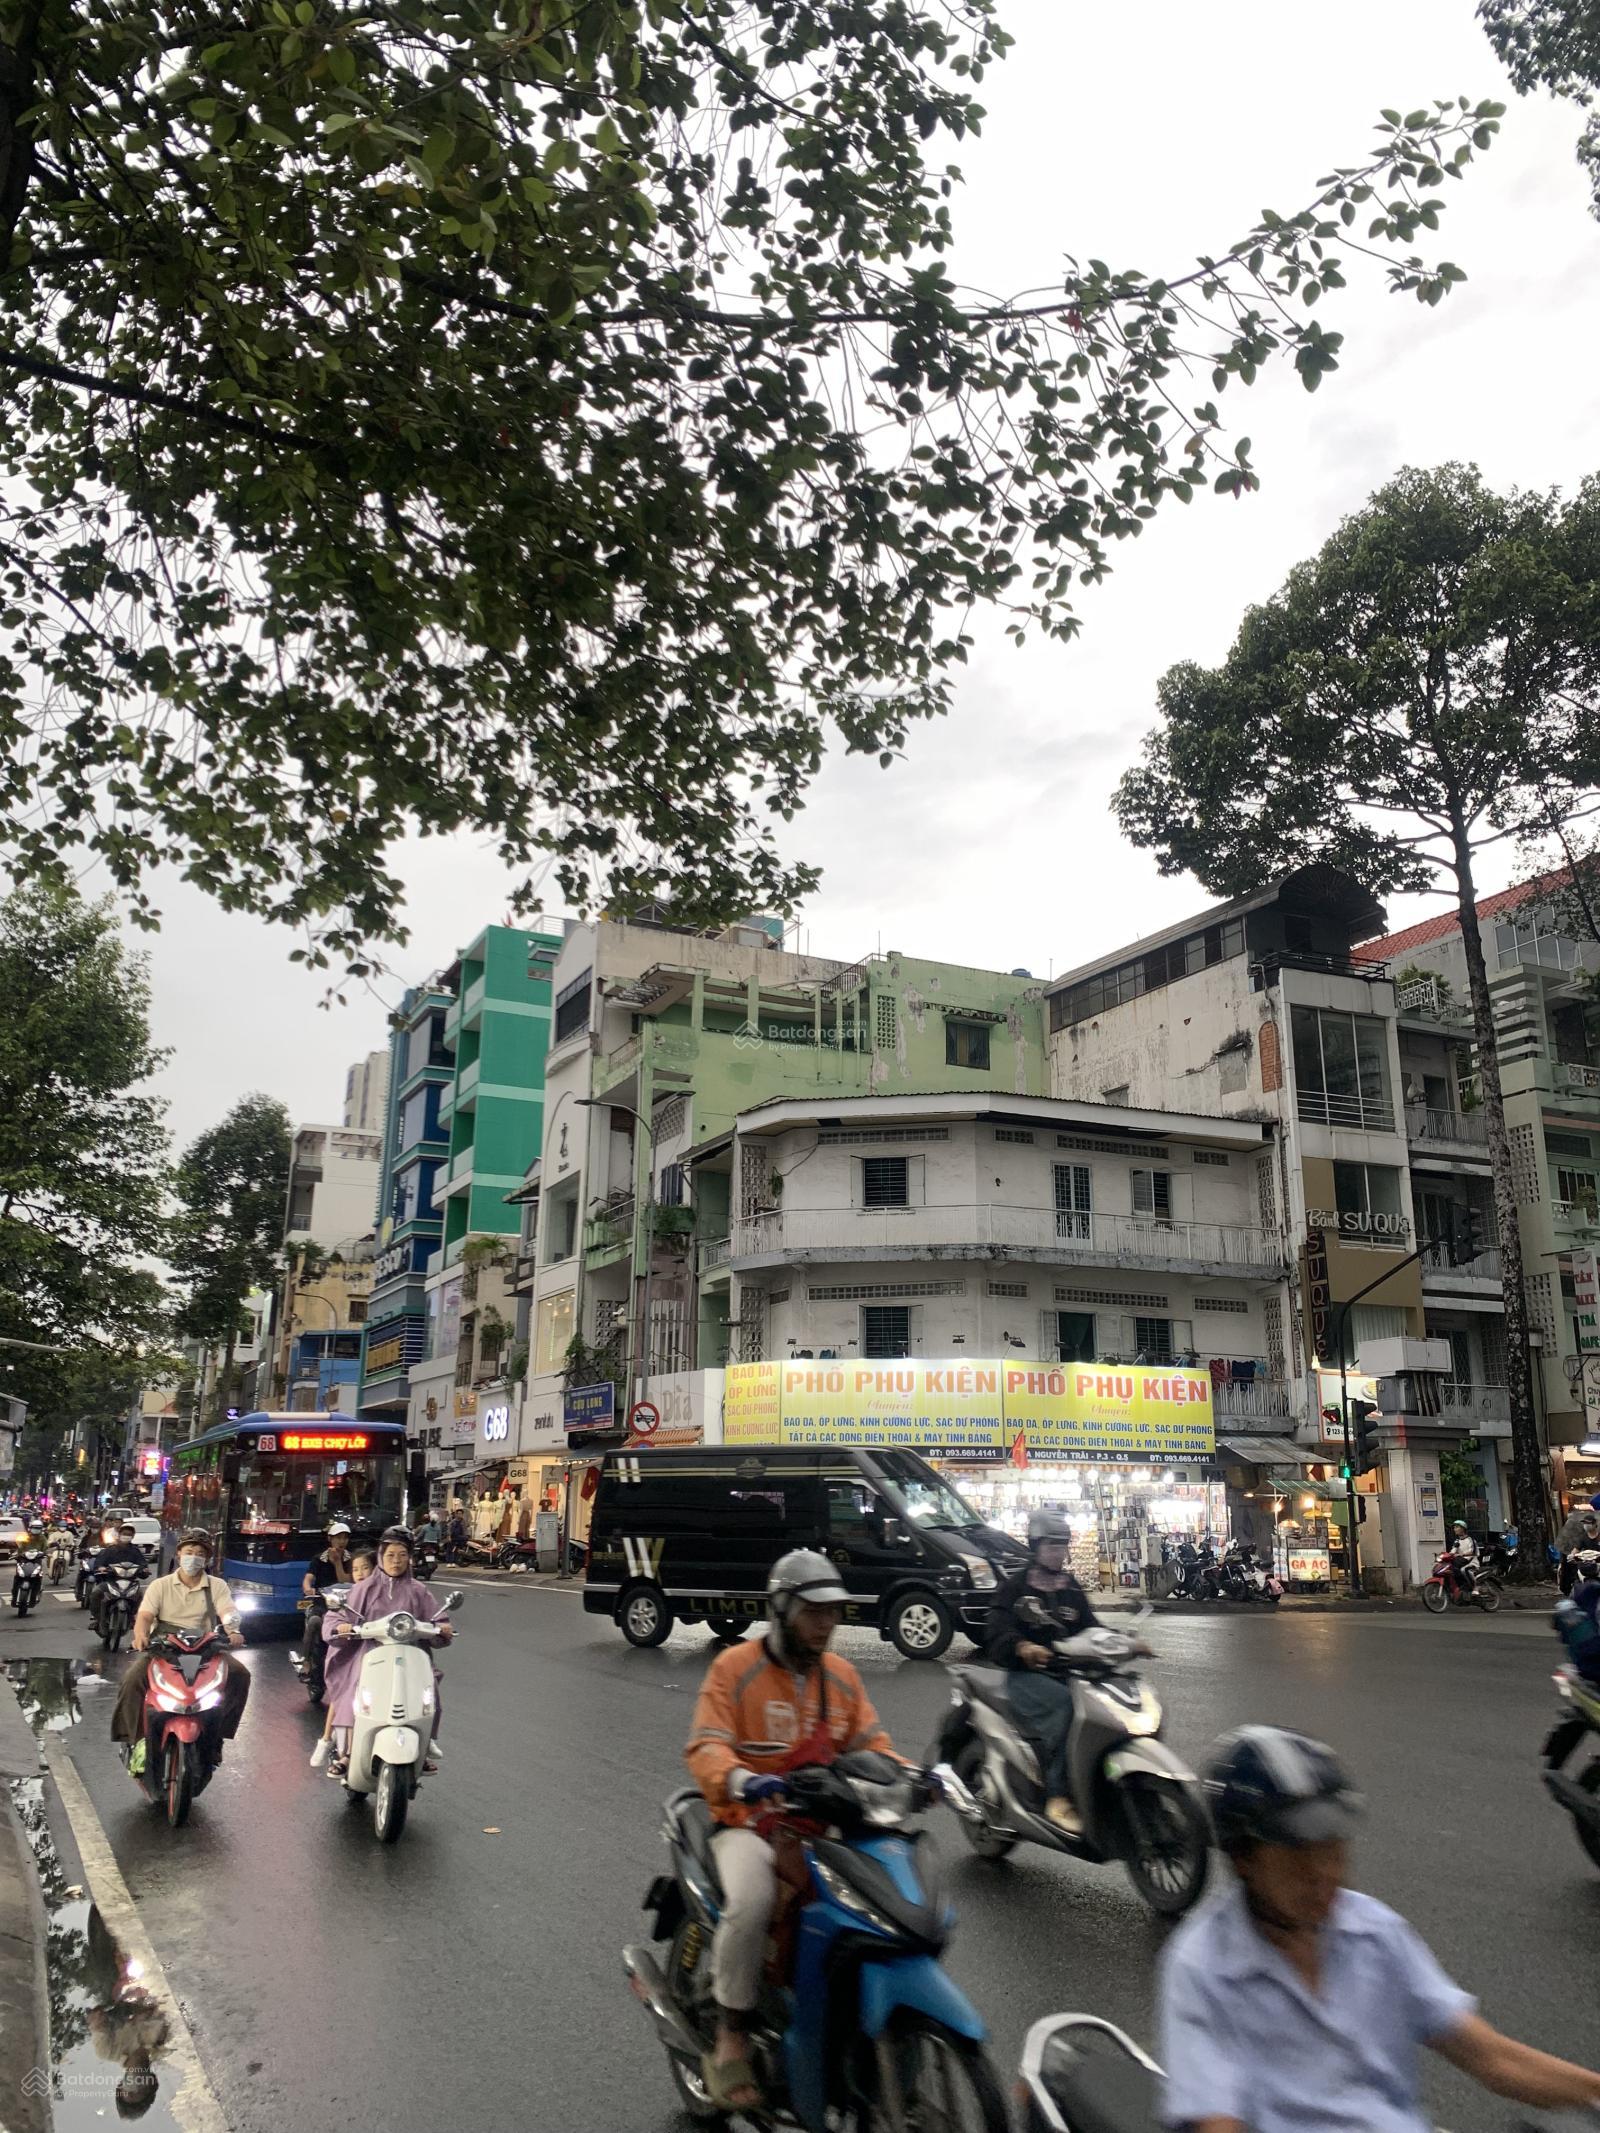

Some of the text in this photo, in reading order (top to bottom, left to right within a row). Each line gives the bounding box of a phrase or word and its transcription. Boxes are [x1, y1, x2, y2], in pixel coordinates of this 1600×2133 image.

[732, 1364, 773, 1380] BAO DA
[786, 1363, 997, 1398] PHỐ PHỤ KIỆN
[1007, 1365, 1208, 1406] PHỐ PHỤ KIỆN
[484, 1406, 509, 1441] G68
[784, 1417, 800, 1427] BAO
[1006, 1418, 1023, 1428] BAO
[260, 1437, 274, 1450] 68
[915, 1433, 920, 1443] &
[1136, 1438, 1142, 1448] &
[945, 1449, 996, 1457] 093.669.4141
[1034, 1449, 1067, 1460] NGUYỄN
[1164, 1454, 1210, 1463] 093.669.4141
[510, 1469, 527, 1478] G68
[1291, 1556, 1306, 1569] GÀ
[690, 1598, 861, 1620] LIMOE
